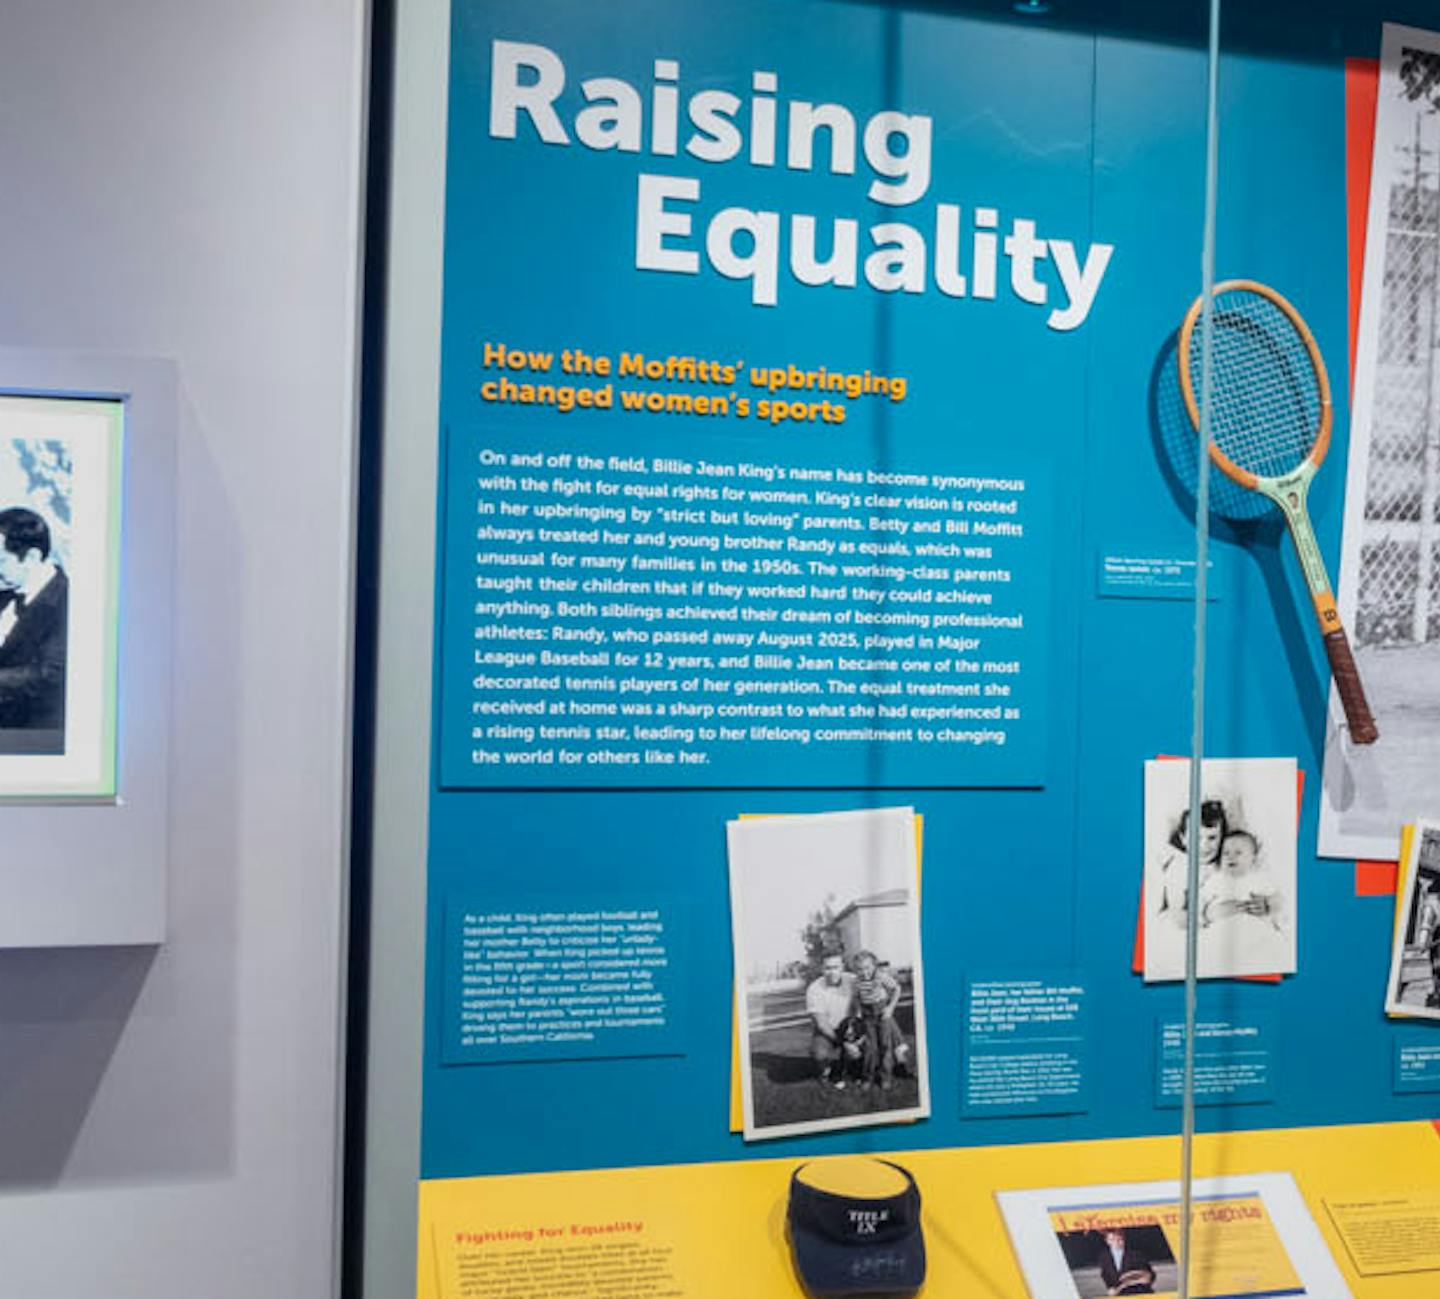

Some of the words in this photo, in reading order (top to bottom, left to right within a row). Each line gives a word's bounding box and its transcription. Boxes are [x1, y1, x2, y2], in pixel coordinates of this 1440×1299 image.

[489, 39, 932, 205] Raising
[635, 173, 1114, 331] Equality
[483, 343, 553, 371] How
[561, 349, 610, 376] the
[618, 353, 742, 384] Moffitts'
[750, 365, 906, 402] upbringing
[481, 377, 612, 411] changed
[620, 391, 750, 417] women's
[756, 397, 846, 424] sports
[480, 449, 505, 464] On
[511, 453, 543, 466] and
[547, 454, 571, 467] off
[576, 456, 604, 469] the
[608, 456, 647, 472] field,
[652, 458, 692, 473] Billie
[696, 460, 735, 475] Jean
[789, 468, 832, 480] name
[836, 468, 863, 482] has
[867, 470, 928, 485] become
[932, 475, 1024, 491] synonymous
[479, 476, 516, 489] with
[521, 477, 548, 491] the
[552, 478, 591, 496] fight
[596, 480, 619, 494] for
[623, 483, 668, 498] equal
[672, 485, 718, 501] rights
[722, 486, 744, 500] for
[748, 491, 809, 503] women.
[864, 494, 901, 507] clear
[904, 496, 948, 509] vision
[951, 497, 963, 511] is
[967, 500, 1017, 513] rooted
[478, 501, 494, 513] in
[500, 501, 528, 515] her
[534, 503, 625, 522] upbringing
[631, 506, 651, 523] by
[711, 510, 737, 523] but
[803, 517, 865, 529] parents.
[869, 516, 908, 534] Betty
[912, 520, 940, 532] and
[946, 519, 968, 534] Bill
[973, 521, 1022, 536] Moffitt
[478, 525, 533, 543] always
[539, 528, 599, 543] treated
[603, 530, 629, 543] her
[634, 531, 665, 545] and
[669, 535, 719, 550] young
[724, 534, 783, 549] brother
[787, 536, 835, 555] Randy
[839, 541, 855, 553] as
[858, 541, 910, 555] equals,
[915, 543, 960, 556] which
[963, 547, 991, 557] was
[477, 552, 544, 565] unusual
[551, 552, 575, 566] for
[580, 556, 626, 571] many
[631, 555, 695, 571] families
[701, 558, 716, 570] in
[721, 559, 747, 572] the
[752, 559, 803, 574] 1950s.
[808, 561, 837, 575] The
[842, 564, 949, 581] working-class
[954, 568, 1010, 582] parents
[476, 576, 531, 592] taught
[539, 577, 577, 590] their
[582, 578, 650, 592] children
[654, 580, 686, 594] that
[692, 581, 703, 594] if
[708, 582, 742, 599] they
[747, 584, 806, 597] worked
[810, 585, 846, 599] hard
[852, 587, 884, 603] they
[888, 589, 931, 602] could
[935, 590, 991, 603] achieve
[476, 601, 554, 618] anything.
[557, 601, 597, 616] Both
[601, 603, 662, 621] siblings
[666, 606, 737, 620] achieved
[741, 606, 777, 620] their
[781, 608, 831, 622] dream
[834, 610, 851, 623] of
[855, 610, 929, 627] becoming
[933, 613, 1022, 627] professional
[475, 624, 548, 639] athletes:
[552, 626, 606, 644] Randy,
[612, 628, 648, 642] who
[652, 629, 707, 644] passed
[713, 632, 753, 646] away
[757, 631, 812, 648] August
[818, 631, 859, 647] 2025,
[864, 634, 914, 650] played
[918, 635, 933, 647] in
[937, 635, 979, 651] Major
[472, 749, 499, 762] the
[505, 749, 553, 763] world
[559, 749, 582, 763] for
[587, 750, 639, 763] others
[645, 749, 674, 763] like
[679, 750, 710, 763] her.
[848, 1209, 890, 1222] TITLE
[857, 1221, 877, 1235] IX
[1202, 1206, 1262, 1224] rights
[455, 1229, 535, 1246] Fighting
[537, 1226, 564, 1239] for
[569, 1220, 643, 1238] Equality
